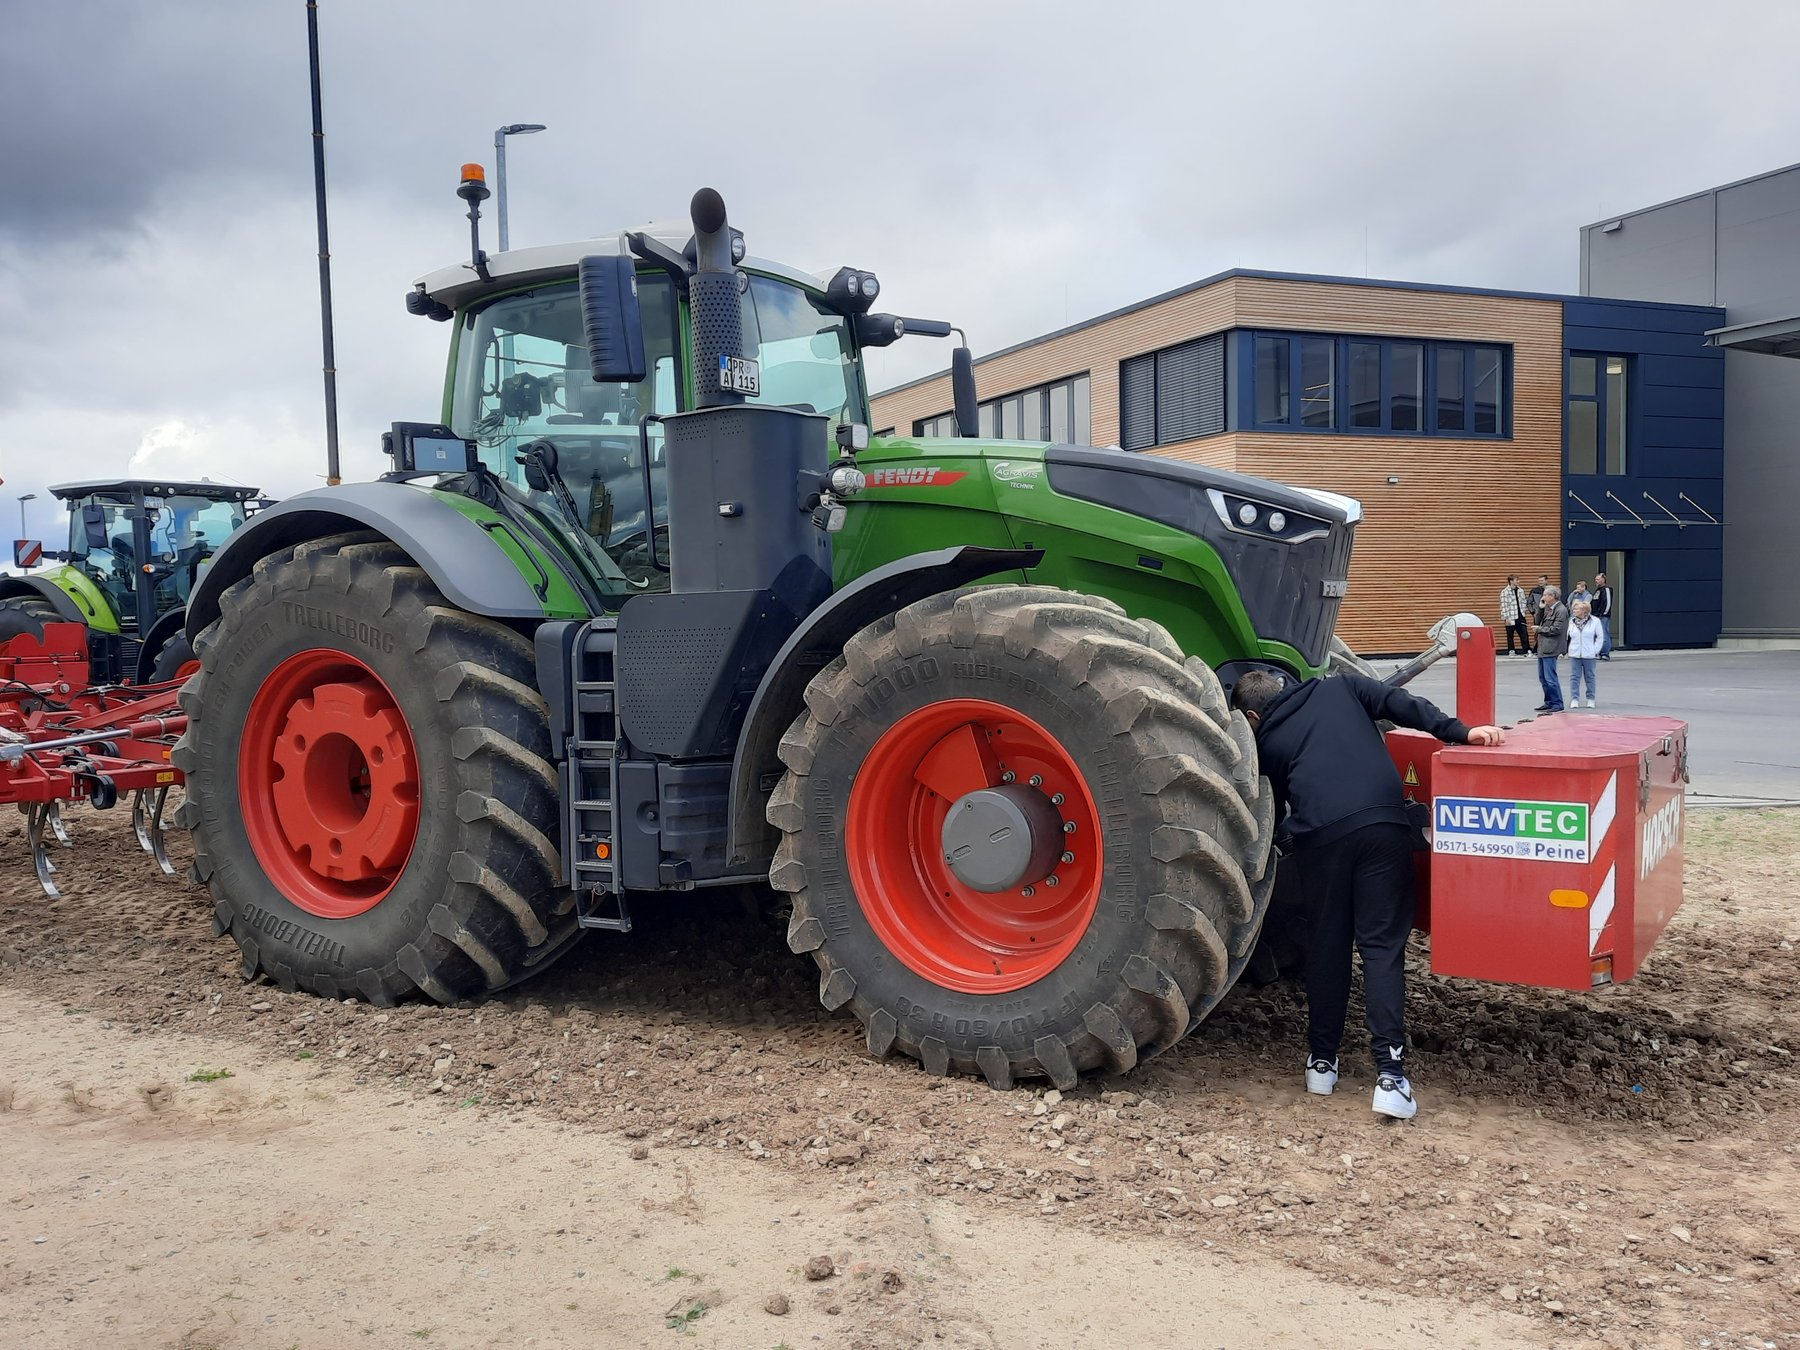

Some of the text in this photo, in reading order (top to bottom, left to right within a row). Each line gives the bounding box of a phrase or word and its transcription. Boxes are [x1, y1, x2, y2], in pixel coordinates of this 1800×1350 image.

[739, 375, 755, 390] 115
[874, 466, 941, 485] FENDT
[994, 468, 1038, 480] AGRAVIS
[1010, 481, 1034, 490] TECHNIK
[282, 601, 394, 654] TRELLEBORG
[1440, 804, 1578, 835] NEWTEC
[1641, 794, 1680, 881] HORSCH
[1436, 840, 1585, 860] 05171-545950 Peine
[242, 903, 345, 969] TRELLEBORG
